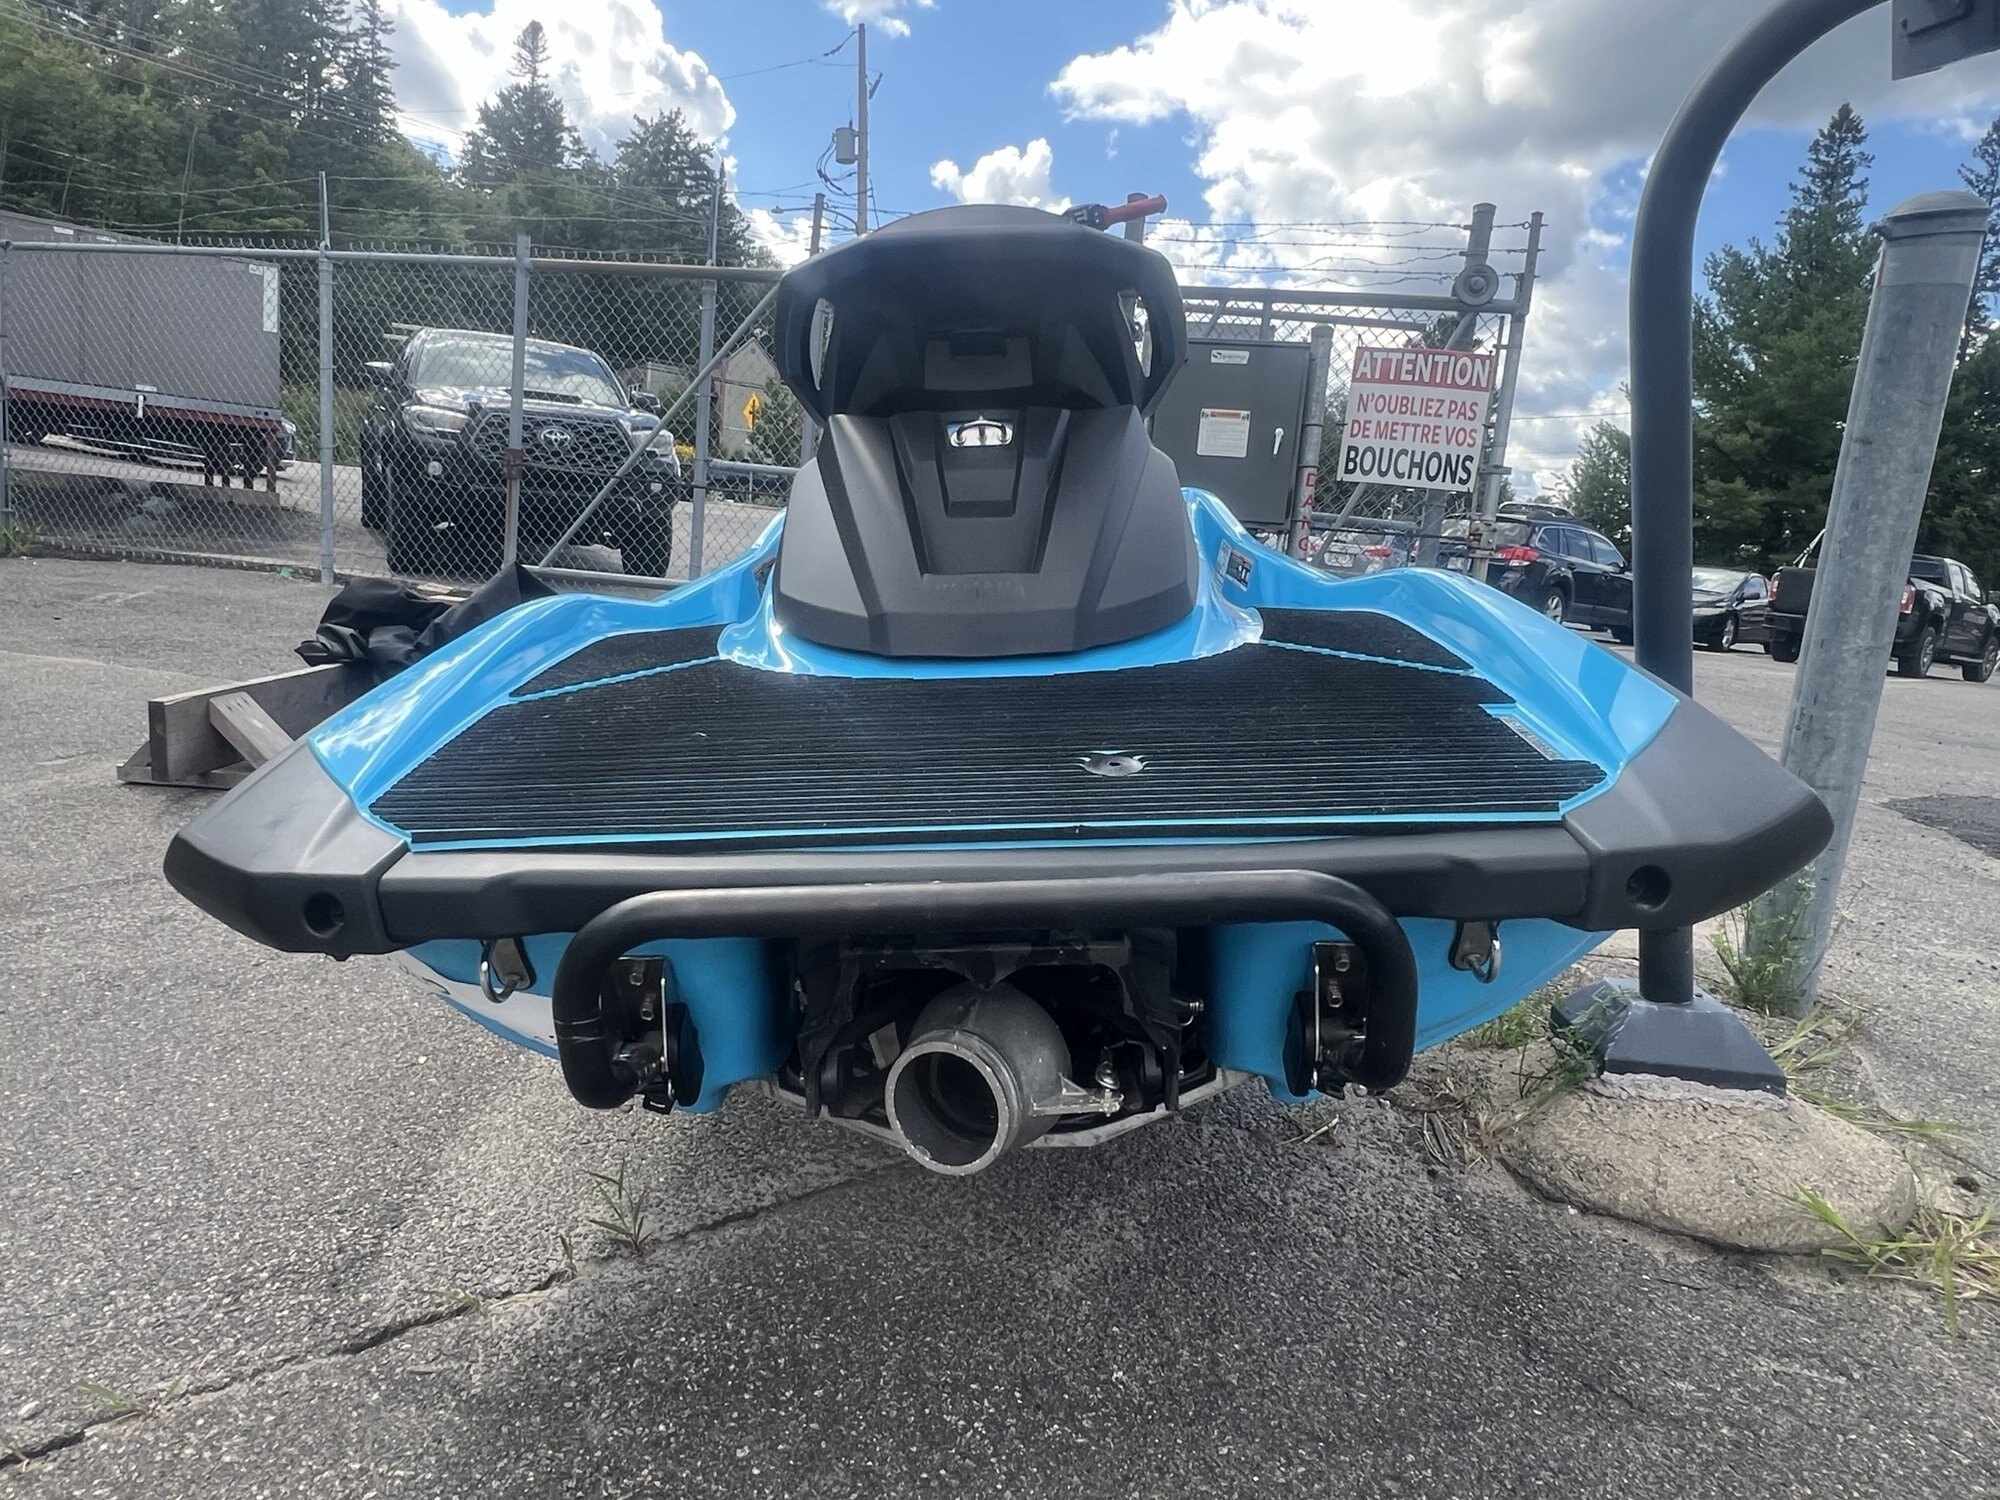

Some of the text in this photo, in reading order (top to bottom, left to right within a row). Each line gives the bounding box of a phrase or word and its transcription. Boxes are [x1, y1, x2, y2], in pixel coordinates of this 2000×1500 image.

[1355, 351, 1491, 388] ATTENTION
[1356, 393, 1479, 422] N'OUBLIEZ PAS
[1350, 419, 1478, 448] DE METTRE VOS
[1344, 445, 1474, 486] BOUCHONS
